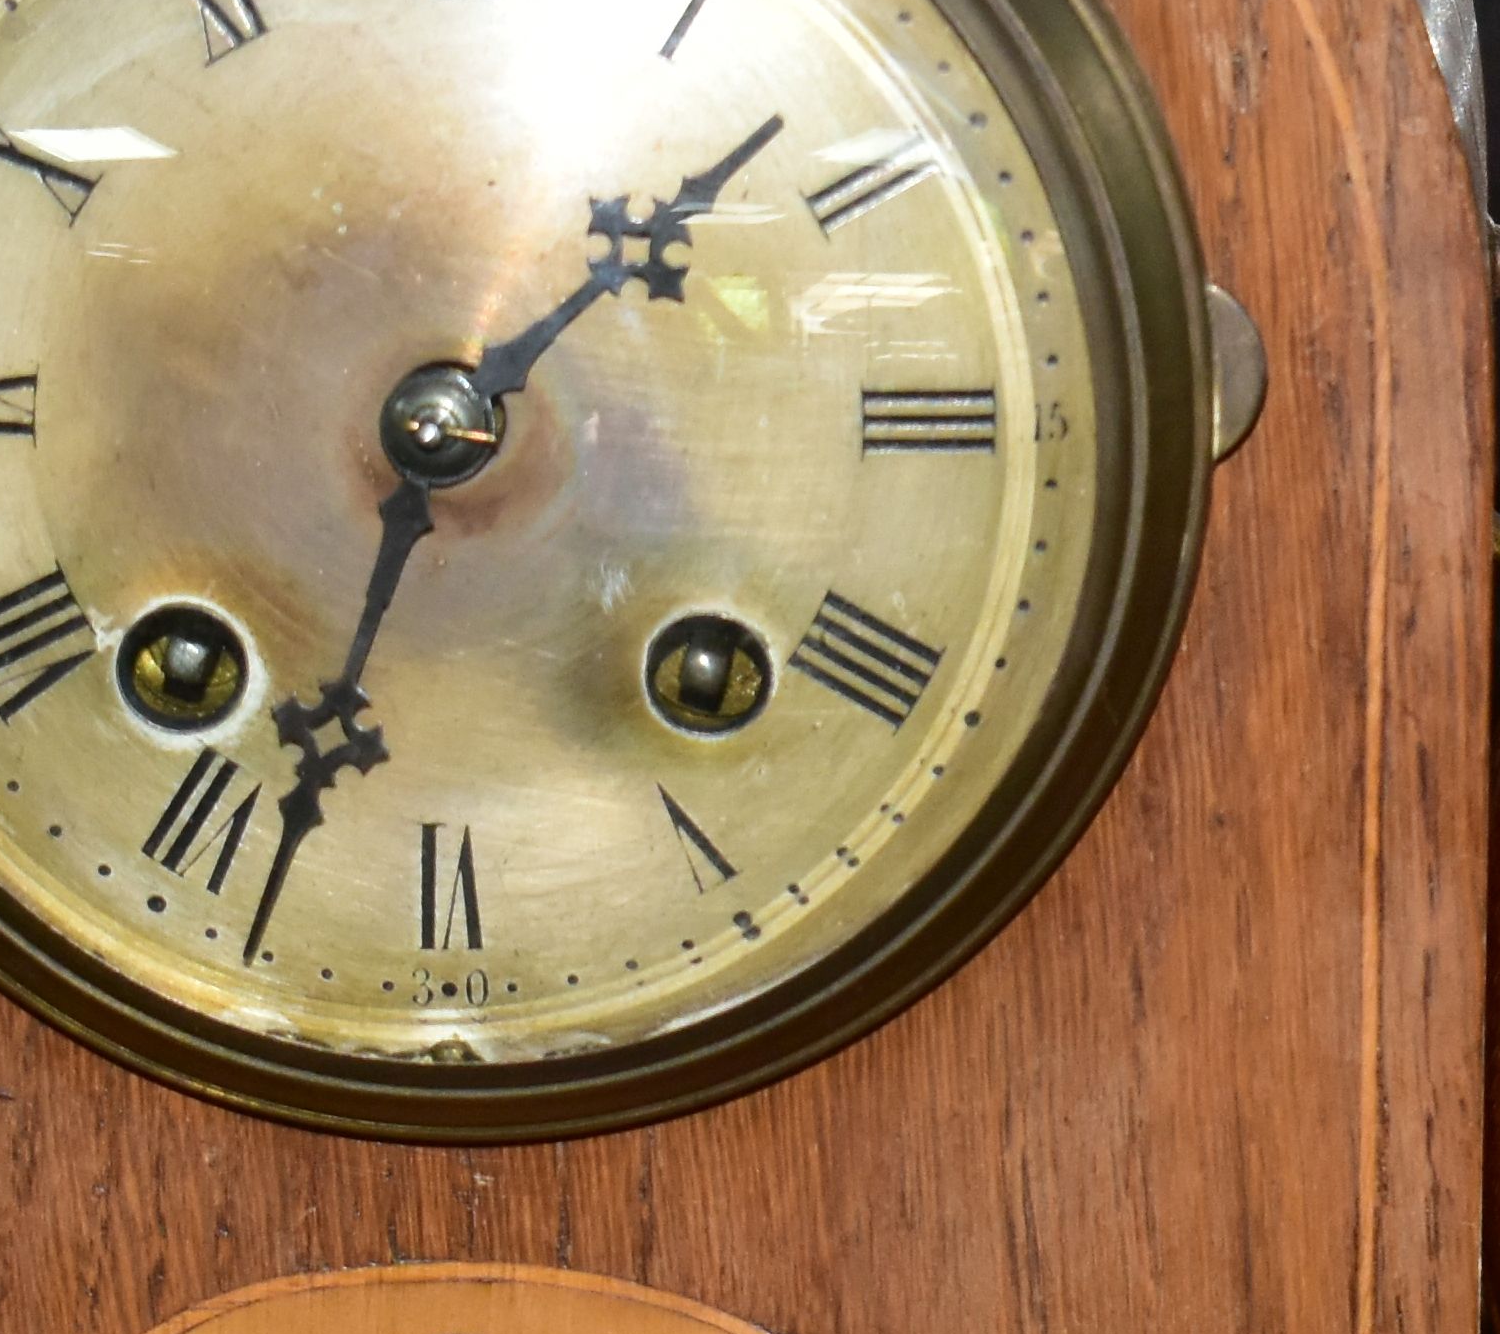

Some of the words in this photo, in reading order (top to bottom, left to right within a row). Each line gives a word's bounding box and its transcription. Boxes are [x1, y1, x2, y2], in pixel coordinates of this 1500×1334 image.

[860, 384, 995, 460] III
[141, 745, 263, 896] VII
[657, 781, 743, 895] V
[415, 822, 483, 950] VI
